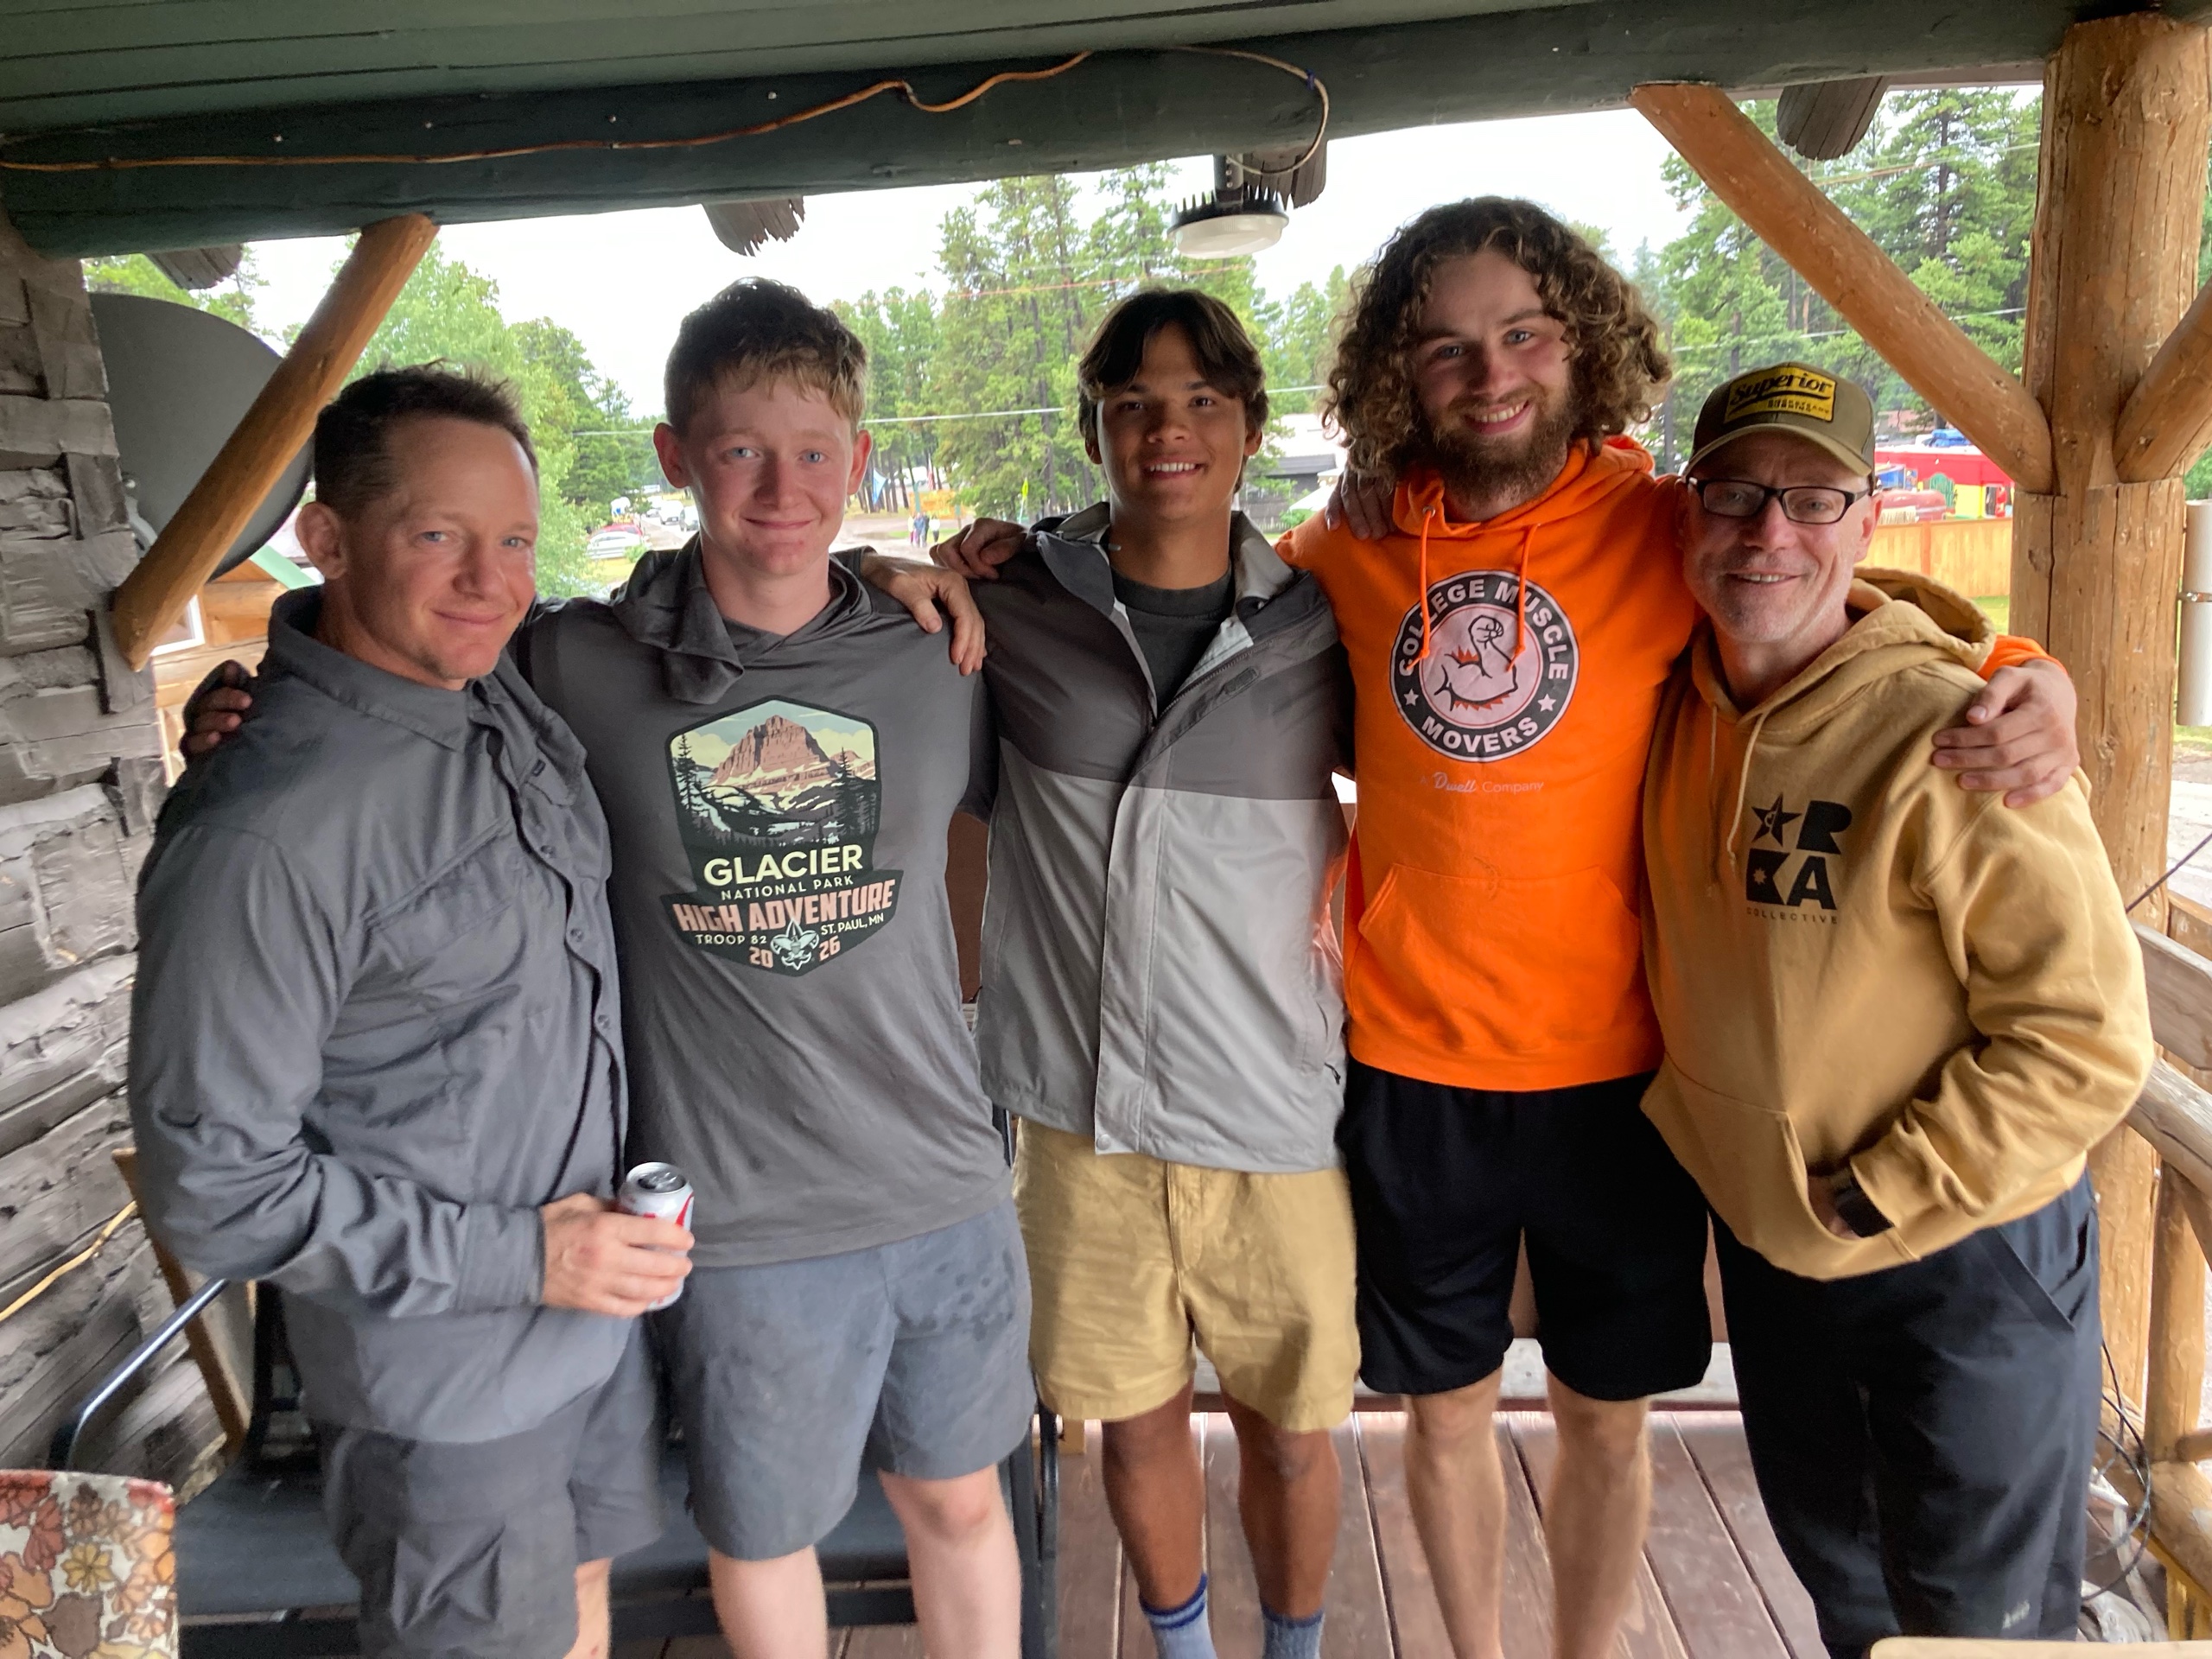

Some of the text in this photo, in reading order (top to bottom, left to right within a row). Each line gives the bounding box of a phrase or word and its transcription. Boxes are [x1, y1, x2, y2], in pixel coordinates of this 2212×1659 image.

[1730, 373, 1832, 405] Superior
[1494, 581, 1569, 680] MUSCLE
[1421, 715, 1538, 753] MOVERS
[1433, 772, 1477, 793] Dwell
[1482, 780, 1545, 795] Company
[703, 844, 863, 886] GLACIER
[721, 875, 854, 900] NATIONAL PARK
[672, 879, 896, 932] HIGH ADVENTURE
[1746, 907, 1838, 925] COLLECTIVE
[695, 934, 767, 945] TROOP 82
[821, 912, 884, 936] ST. PAUL, MN
[749, 935, 841, 969] 20 26
